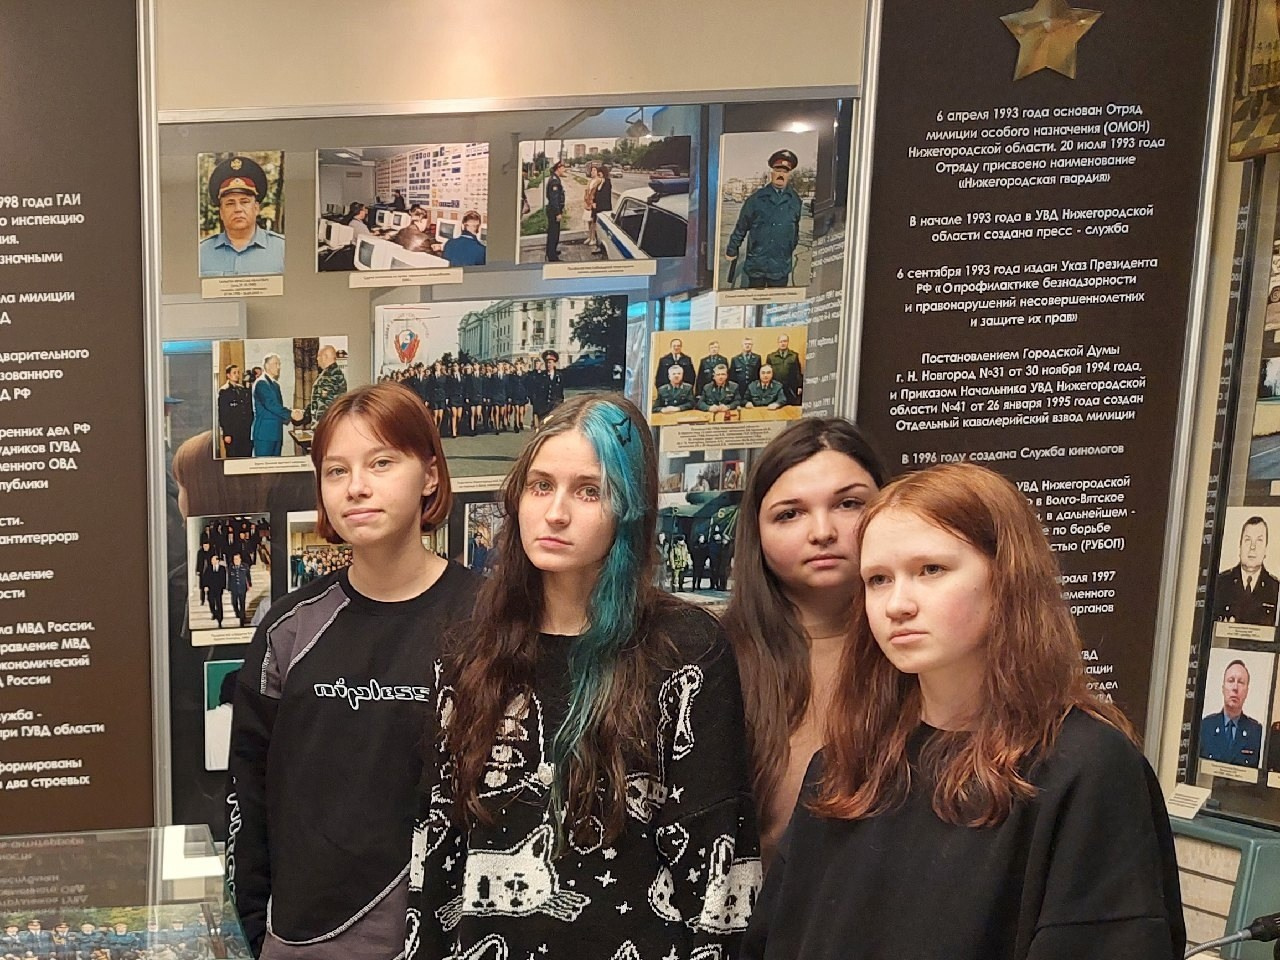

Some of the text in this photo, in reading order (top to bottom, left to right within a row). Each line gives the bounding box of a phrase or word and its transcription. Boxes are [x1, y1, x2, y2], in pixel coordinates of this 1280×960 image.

[936, 103, 1144, 123] 6 апреля 1993 года основан Отряд
[925, 119, 1150, 140] милиции особого назначения (ОМОН)
[935, 155, 1137, 175] Отряду присвоено наименование
[958, 173, 1111, 189] «Нижегородская гвардия»
[21, 197, 53, 208] года
[55, 193, 81, 206] ГАИ
[909, 204, 1154, 227] В начале 1993 года в УВД Нижегородской
[896, 258, 1158, 279] 6 сентября 1993 года издан Указ Президента
[18, 291, 75, 303] милиции
[904, 292, 1145, 314] и правонарушений несовершеннолетних
[969, 313, 1078, 327] и защите их прав»
[921, 344, 1120, 364] Постановлением Городской Думы
[889, 375, 1146, 401] и Приказом Начальника УВД Нижегородской
[895, 410, 1136, 431] Отдельный кавалерийский взвод милиции
[45, 426, 71, 437] дел
[72, 423, 91, 434] РФ
[1015, 475, 1131, 493] УВД Нижегородской
[1045, 493, 1125, 505] Волго-Вятское
[1080, 537, 1125, 553] (РУБОП)
[1092, 570, 1116, 582] 1997
[1070, 604, 1114, 616] органов
[6, 674, 51, 686] России
